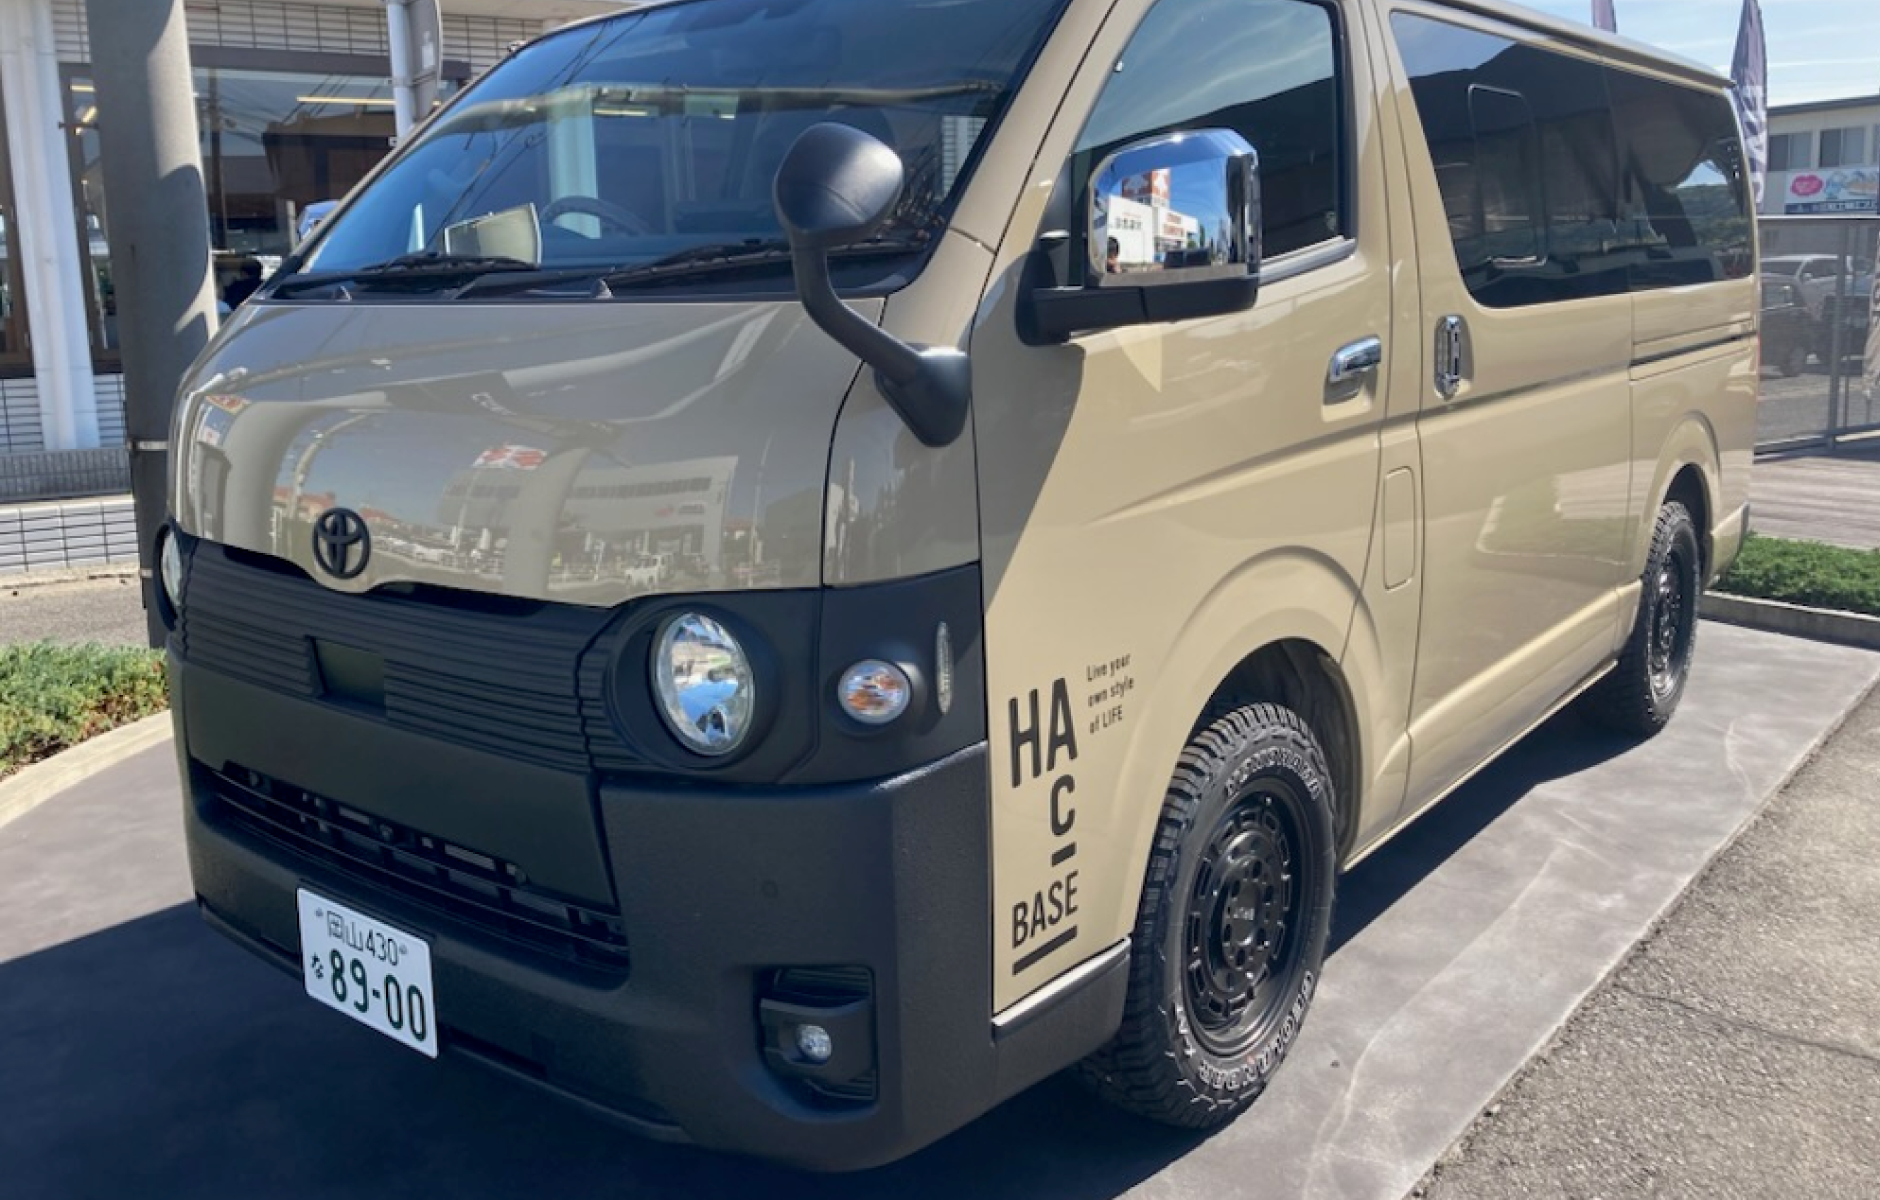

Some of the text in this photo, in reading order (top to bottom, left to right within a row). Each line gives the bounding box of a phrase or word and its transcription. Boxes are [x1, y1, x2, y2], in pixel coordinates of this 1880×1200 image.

[1086, 653, 1130, 682] Live your
[1088, 676, 1134, 708] own style
[1009, 677, 1077, 788] HA
[1089, 704, 1122, 735] of LIFE
[1012, 870, 1078, 949] BASE
[329, 948, 426, 1042] 89-00
